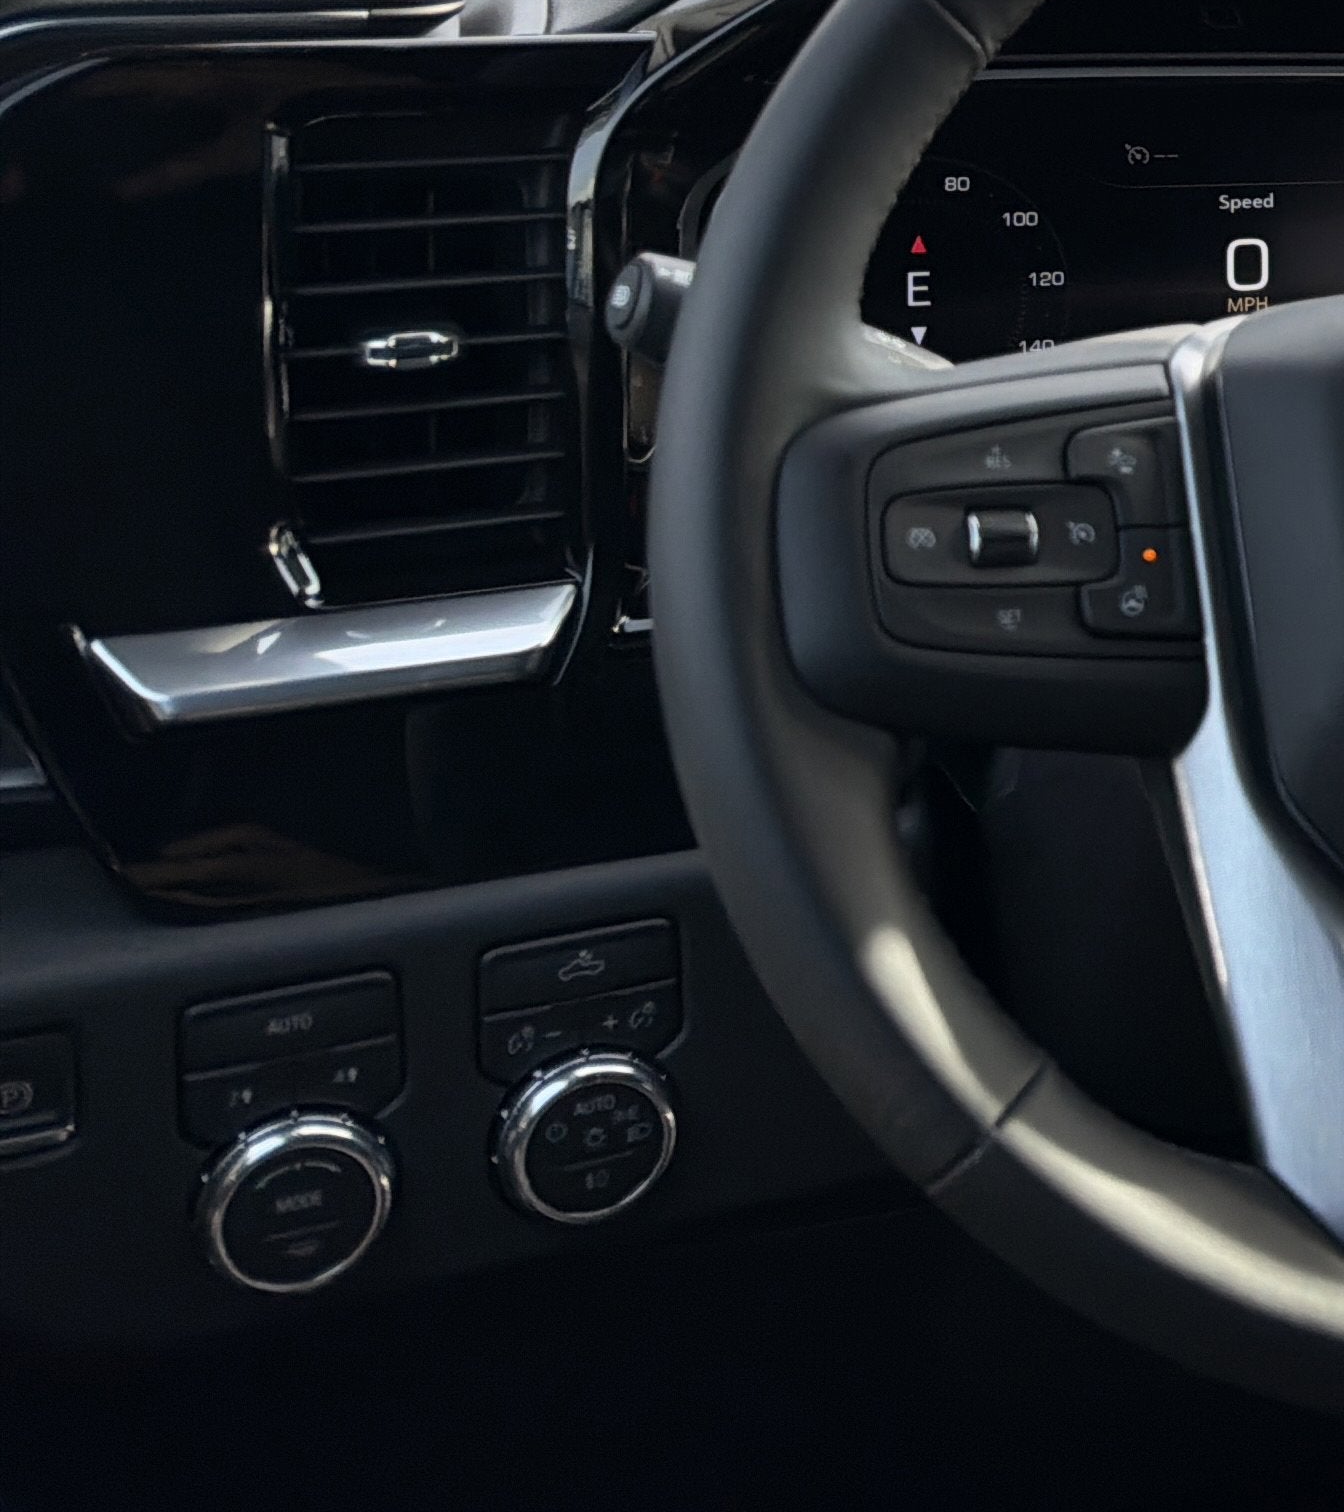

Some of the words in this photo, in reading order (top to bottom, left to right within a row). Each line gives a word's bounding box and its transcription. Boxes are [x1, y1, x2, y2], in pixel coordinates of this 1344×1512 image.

[944, 176, 971, 193] 80
[1219, 193, 1274, 212] Speed
[1002, 211, 1039, 228] 100
[1226, 238, 1269, 291] 0
[906, 271, 931, 307] E
[1028, 271, 1065, 288] 120
[1227, 295, 1269, 314] MPH
[1018, 338, 1055, 354] 140
[267, 1015, 313, 1035] AUTO
[573, 1095, 615, 1116] AUTO
[275, 1192, 322, 1213] MODE
